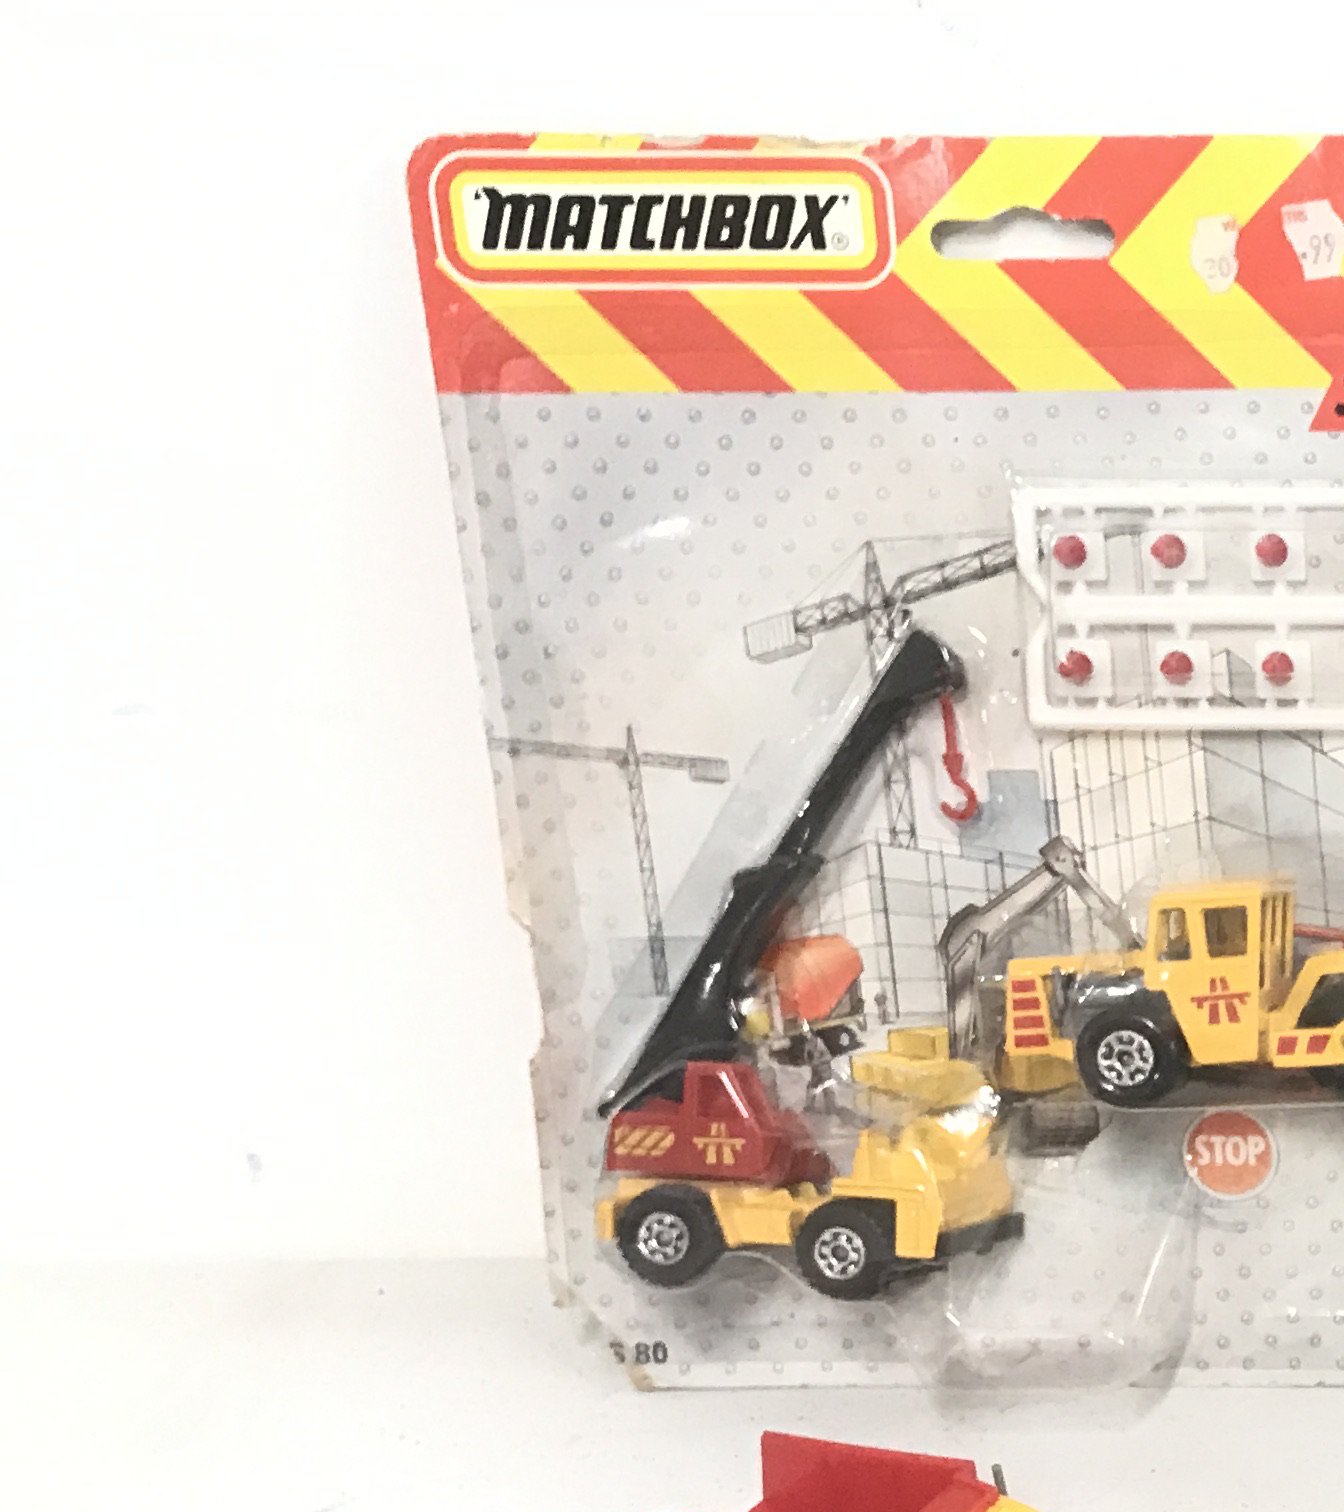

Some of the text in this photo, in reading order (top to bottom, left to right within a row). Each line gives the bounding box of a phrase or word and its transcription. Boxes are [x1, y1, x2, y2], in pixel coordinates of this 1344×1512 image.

[475, 186, 850, 251] MATCHBOX
[1194, 1133, 1267, 1168] STOP
[634, 1340, 669, 1365] 80
